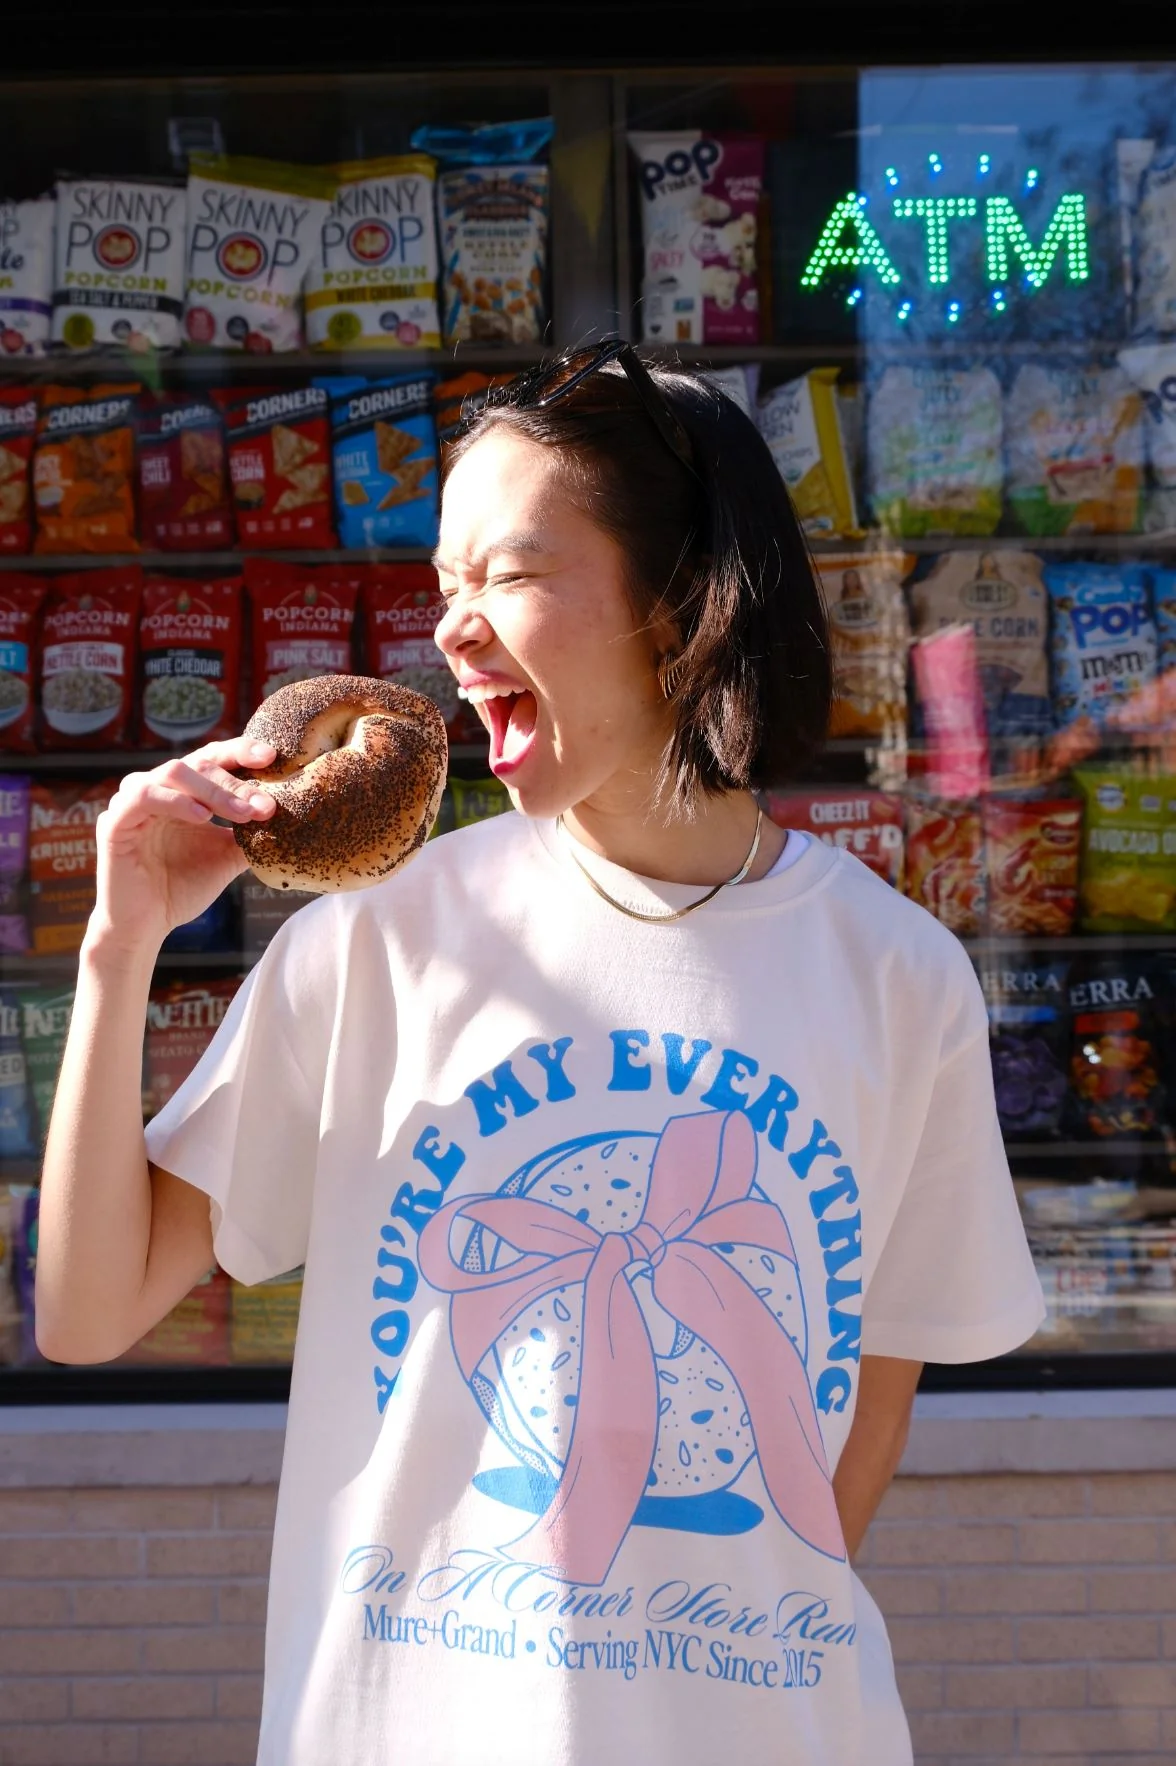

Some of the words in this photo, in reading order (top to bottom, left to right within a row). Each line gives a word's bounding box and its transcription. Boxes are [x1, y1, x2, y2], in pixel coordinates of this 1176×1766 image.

[640, 138, 720, 202] POP
[72, 187, 176, 224] SKINNY
[198, 189, 310, 238] SKINNY
[66, 221, 171, 274] POP
[321, 217, 424, 269] POP
[800, 192, 1090, 288] ATM
[188, 224, 299, 287] POP
[65, 272, 167, 291] POPCORN
[324, 266, 427, 286] POPCORN
[187, 278, 292, 308] POPCORN
[246, 387, 328, 423] CORNERS
[347, 381, 429, 418] CORNERS
[48, 399, 132, 429] CORNERS
[43, 608, 131, 631] POPCORN
[140, 613, 231, 632] POPCORN
[262, 605, 354, 623] POPCORN
[280, 619, 340, 633] INDIANA
[375, 605, 445, 625] POPCO
[392, 619, 439, 633] INDIA
[990, 616, 1039, 638] CORN
[153, 627, 213, 641] INDIANA
[145, 656, 173, 676] WHITE
[174, 656, 221, 677] CHEDDAR
[272, 649, 308, 667] PINK
[311, 648, 345, 667] SALT
[30, 840, 97, 860] KRINKL
[52, 857, 87, 872] CUT
[981, 971, 1061, 993] ERRA
[1069, 976, 1156, 1008] ERRA
[370, 1125, 467, 1415] YOU'RE
[464, 1036, 577, 1138] MY
[606, 1028, 863, 1416] EVERYTHING
[341, 1544, 408, 1594] On
[491, 1561, 634, 1618] Corner
[645, 1579, 769, 1637] Store
[772, 1590, 857, 1646] Run
[362, 1603, 517, 1660] Mure+Grand
[546, 1625, 640, 1681] Serving
[643, 1629, 702, 1673] NYC
[706, 1640, 779, 1689] Since
[782, 1648, 825, 1689] 2015
